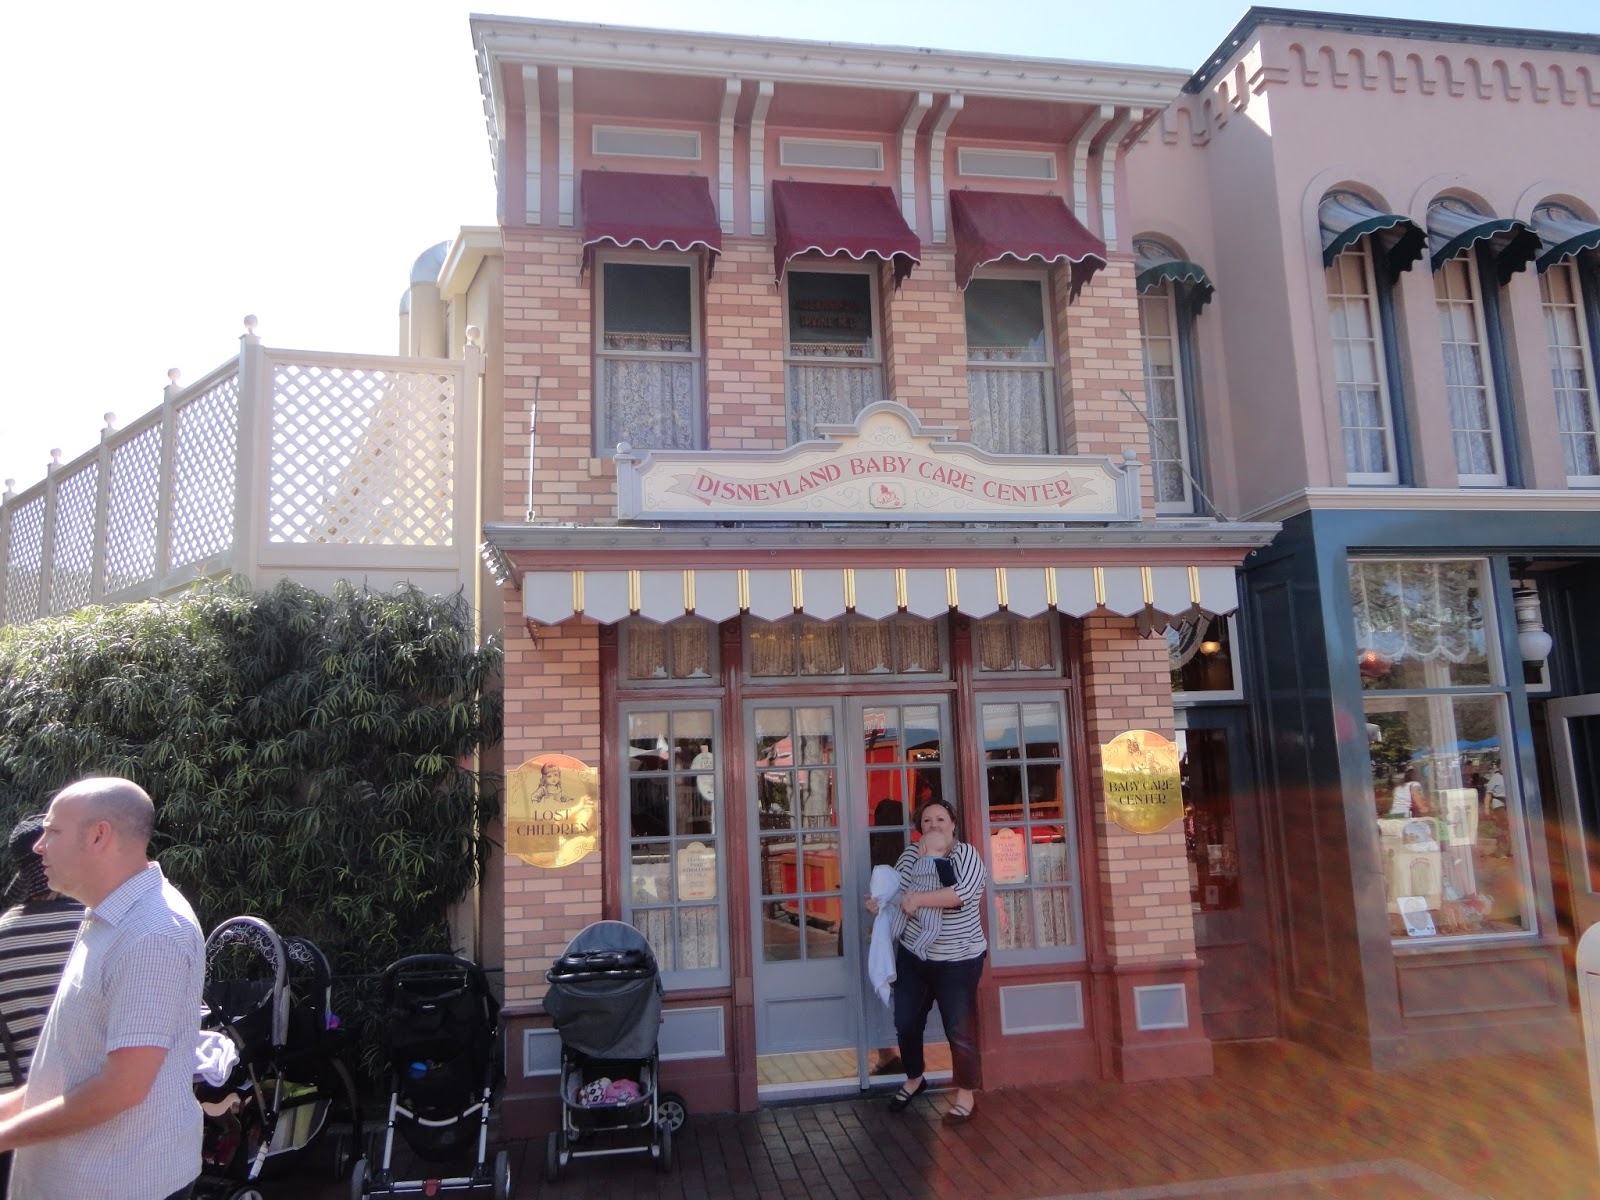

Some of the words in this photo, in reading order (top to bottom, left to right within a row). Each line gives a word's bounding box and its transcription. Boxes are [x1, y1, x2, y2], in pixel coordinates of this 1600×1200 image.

[697, 464, 841, 501] DISNEYLAND
[850, 456, 911, 475] BABY
[918, 461, 976, 493] CARE
[982, 479, 1072, 502] CENTER
[1109, 781, 1140, 792] BABY
[1142, 779, 1174, 791] CARE
[1119, 794, 1166, 805] CENTER
[534, 809, 570, 821] LOST
[516, 823, 589, 836] CHILDREN
